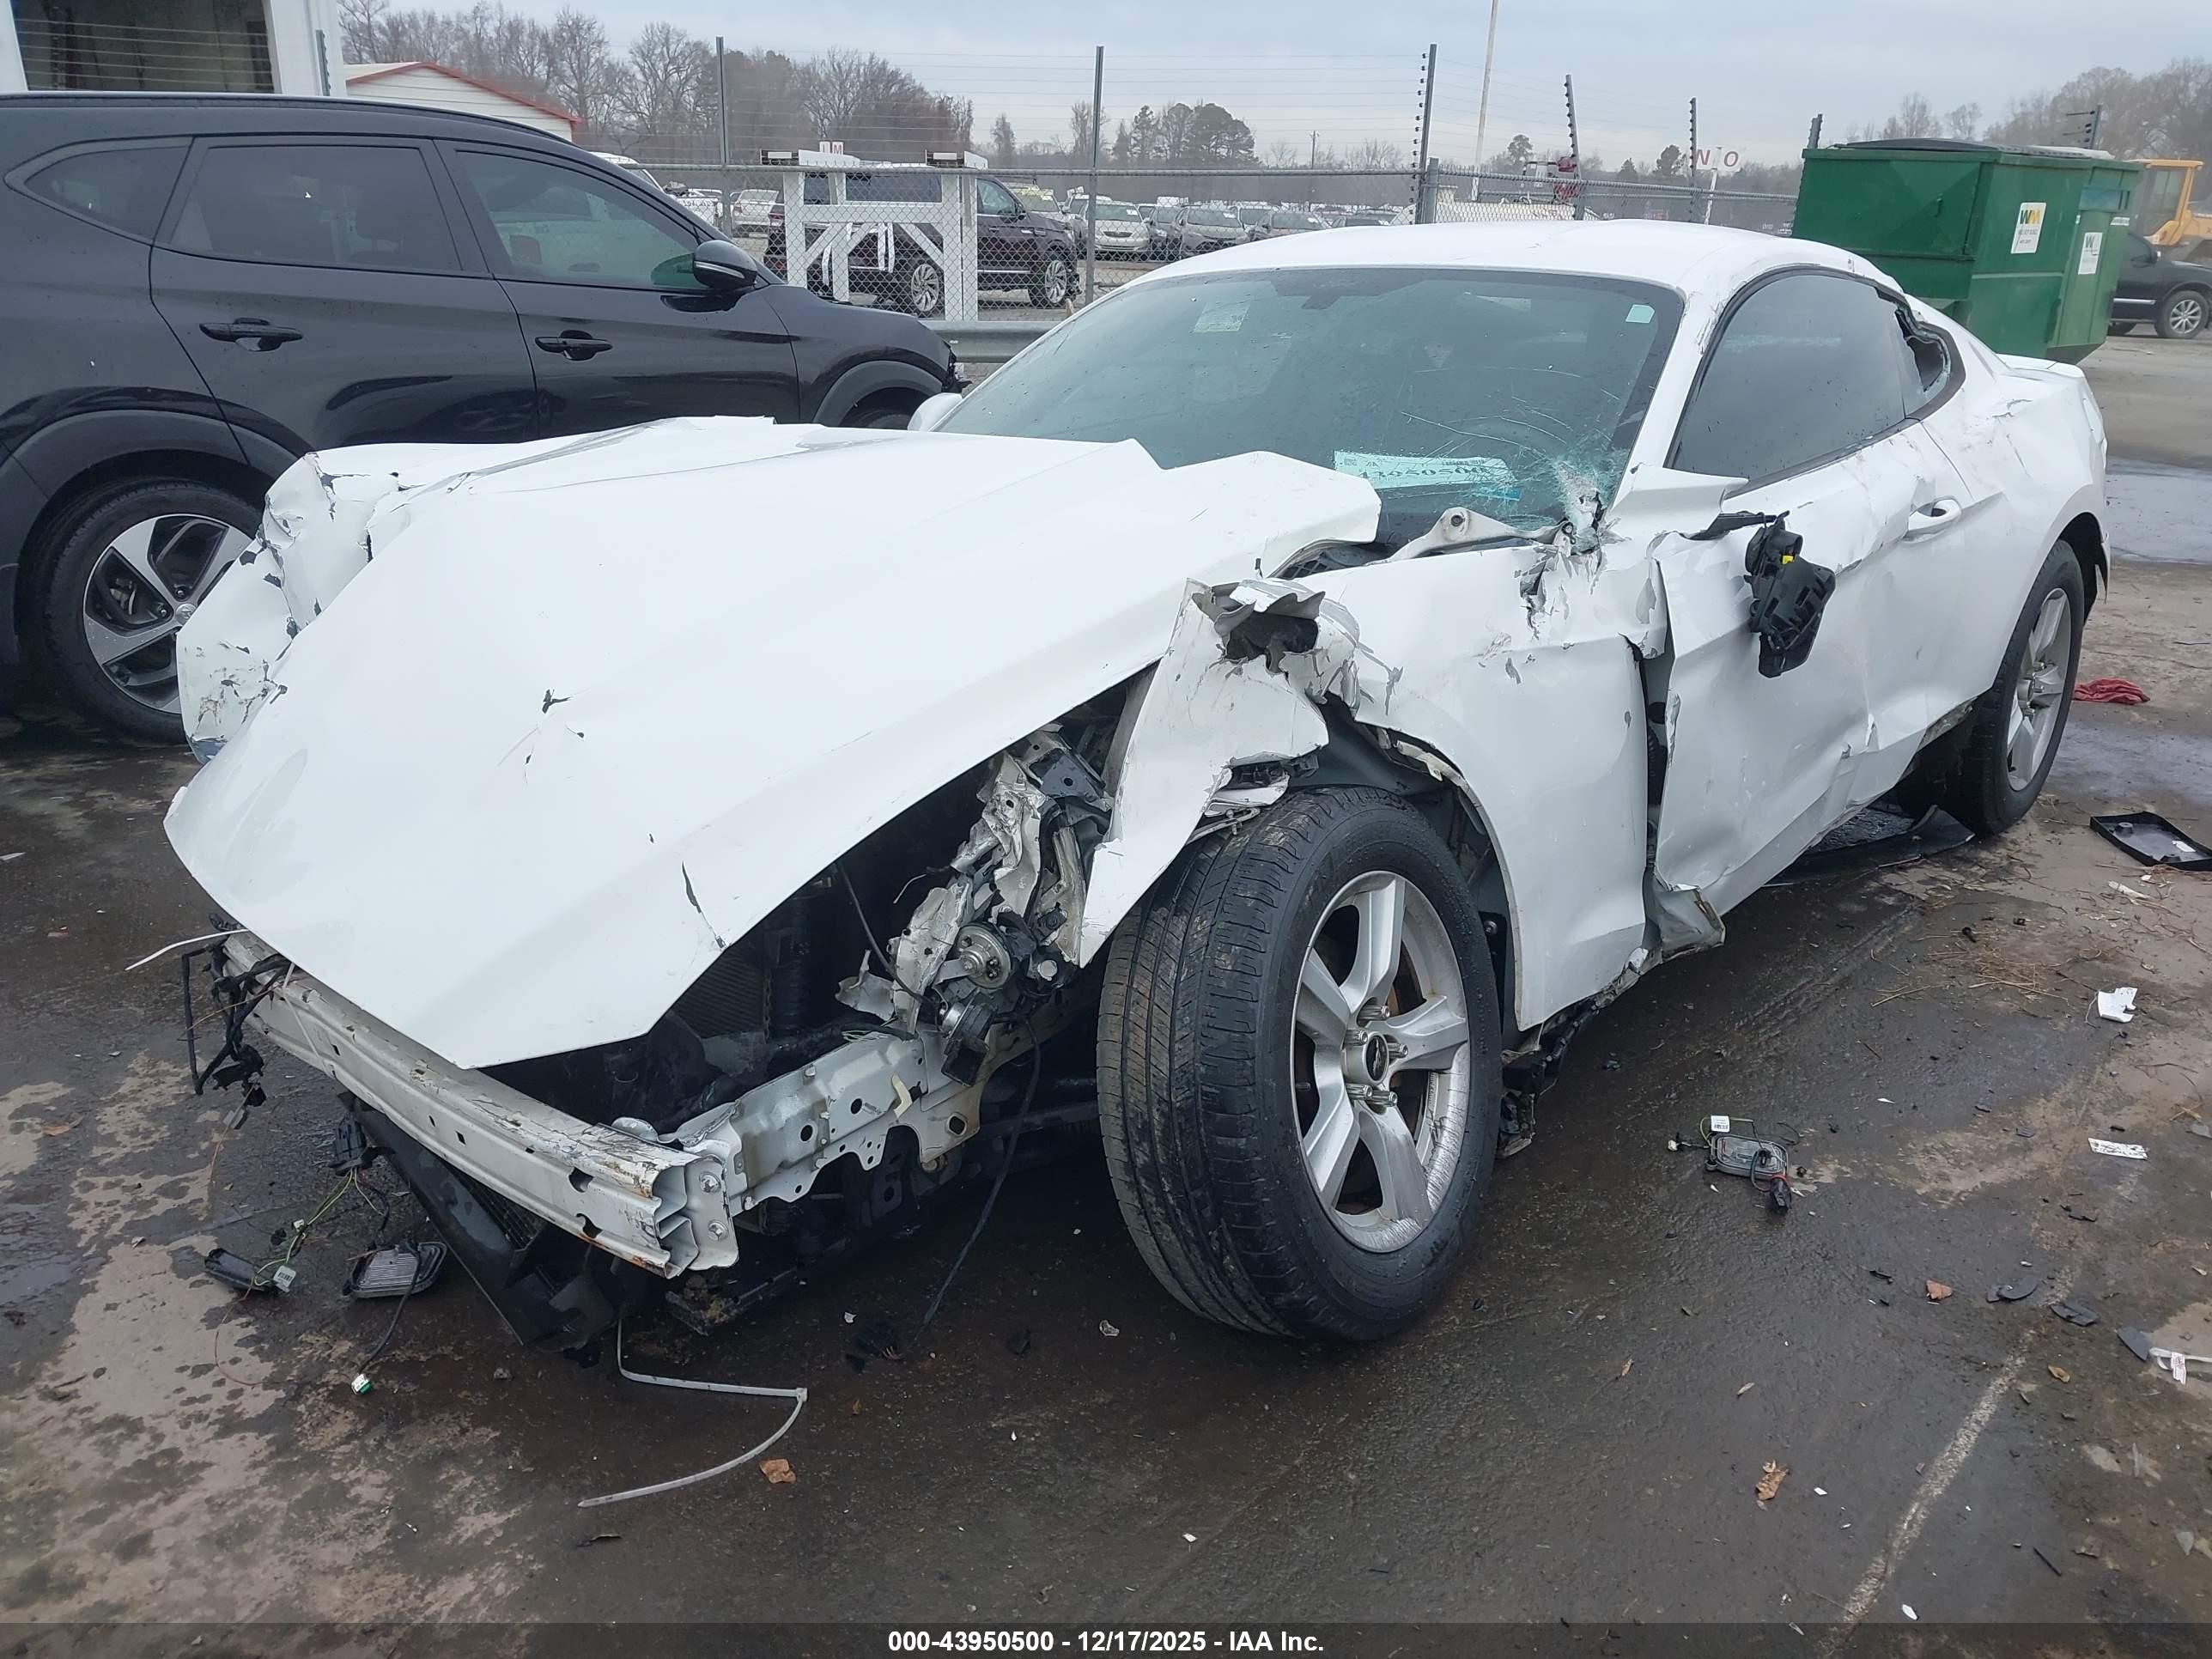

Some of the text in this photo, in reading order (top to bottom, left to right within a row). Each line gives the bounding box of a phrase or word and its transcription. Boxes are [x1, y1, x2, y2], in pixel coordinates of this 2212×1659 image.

[1696, 149, 1711, 166] N
[1723, 150, 1739, 167] O
[2020, 209, 2042, 225] WM
